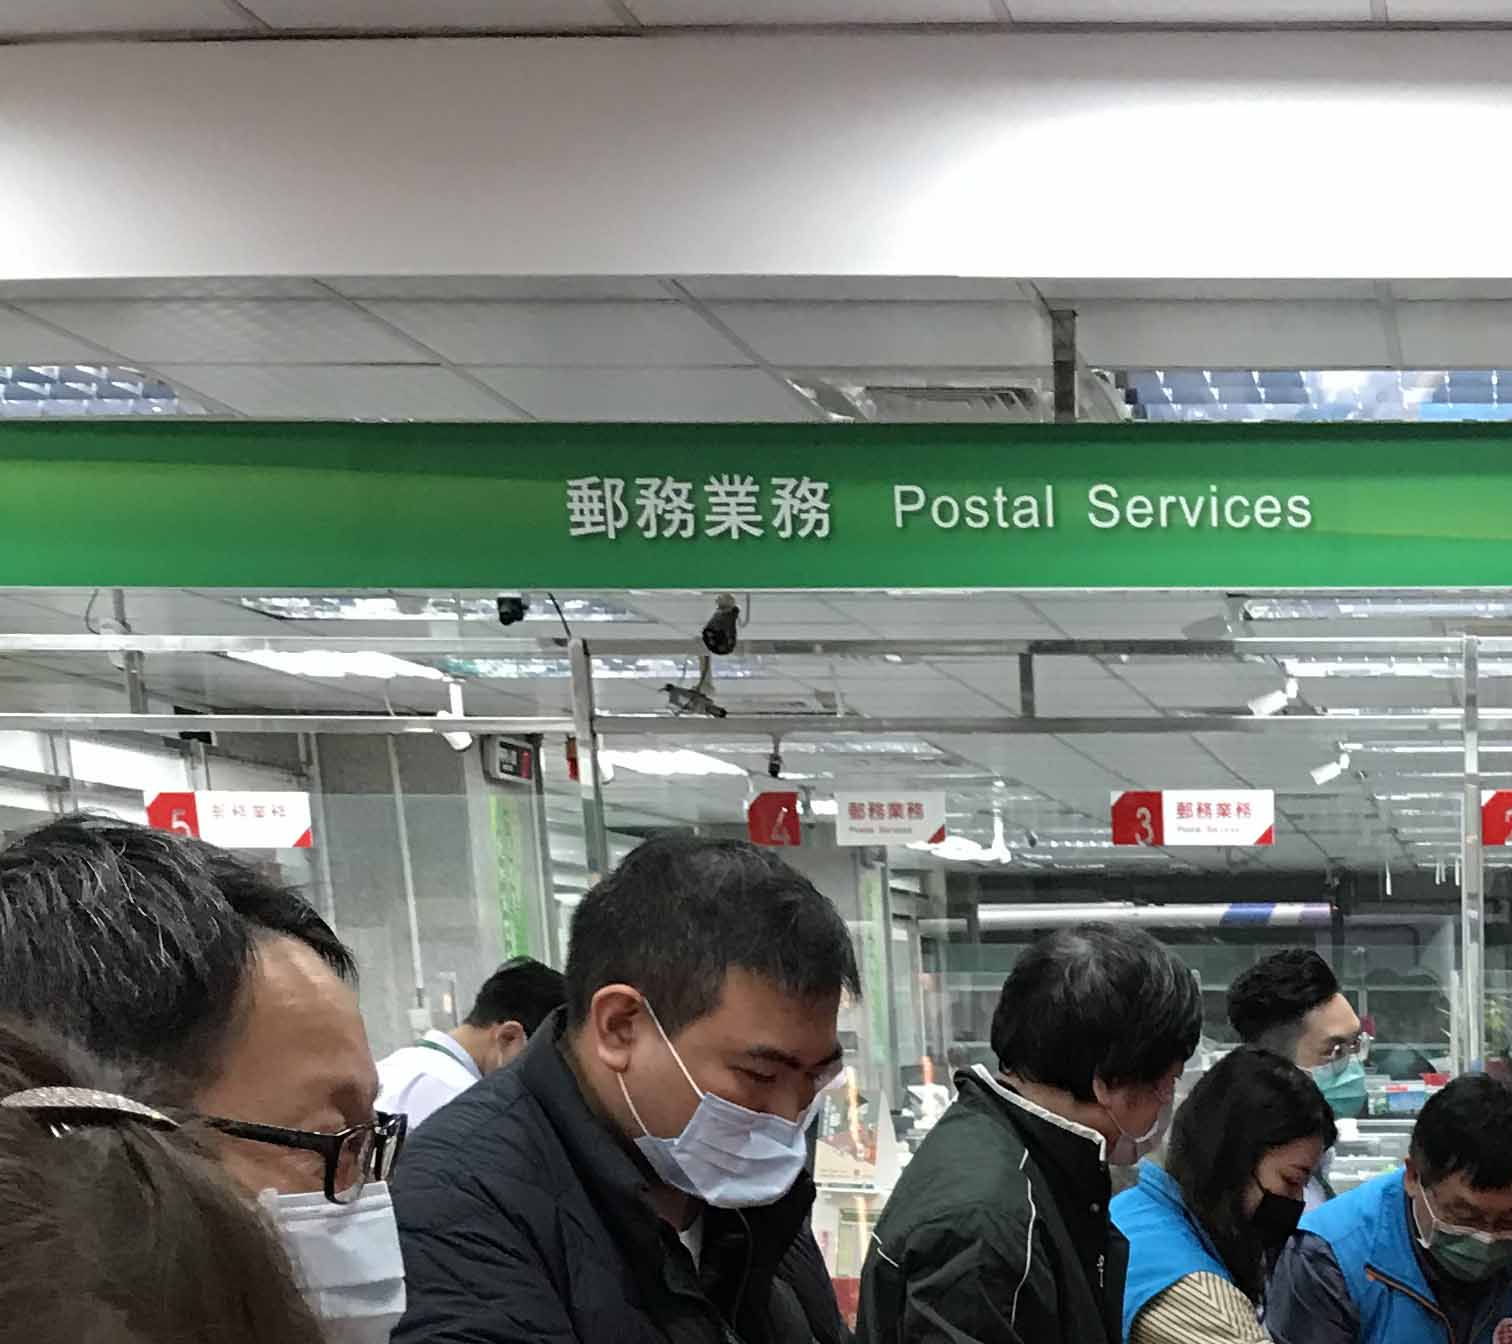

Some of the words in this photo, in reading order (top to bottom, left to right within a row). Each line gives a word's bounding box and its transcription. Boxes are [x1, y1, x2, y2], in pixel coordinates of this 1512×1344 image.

[566, 475, 832, 540] 郵務業務
[893, 485, 1054, 528] Postal
[1088, 485, 1312, 528] Services
[770, 806, 791, 842] 4
[1136, 807, 1153, 845] 3
